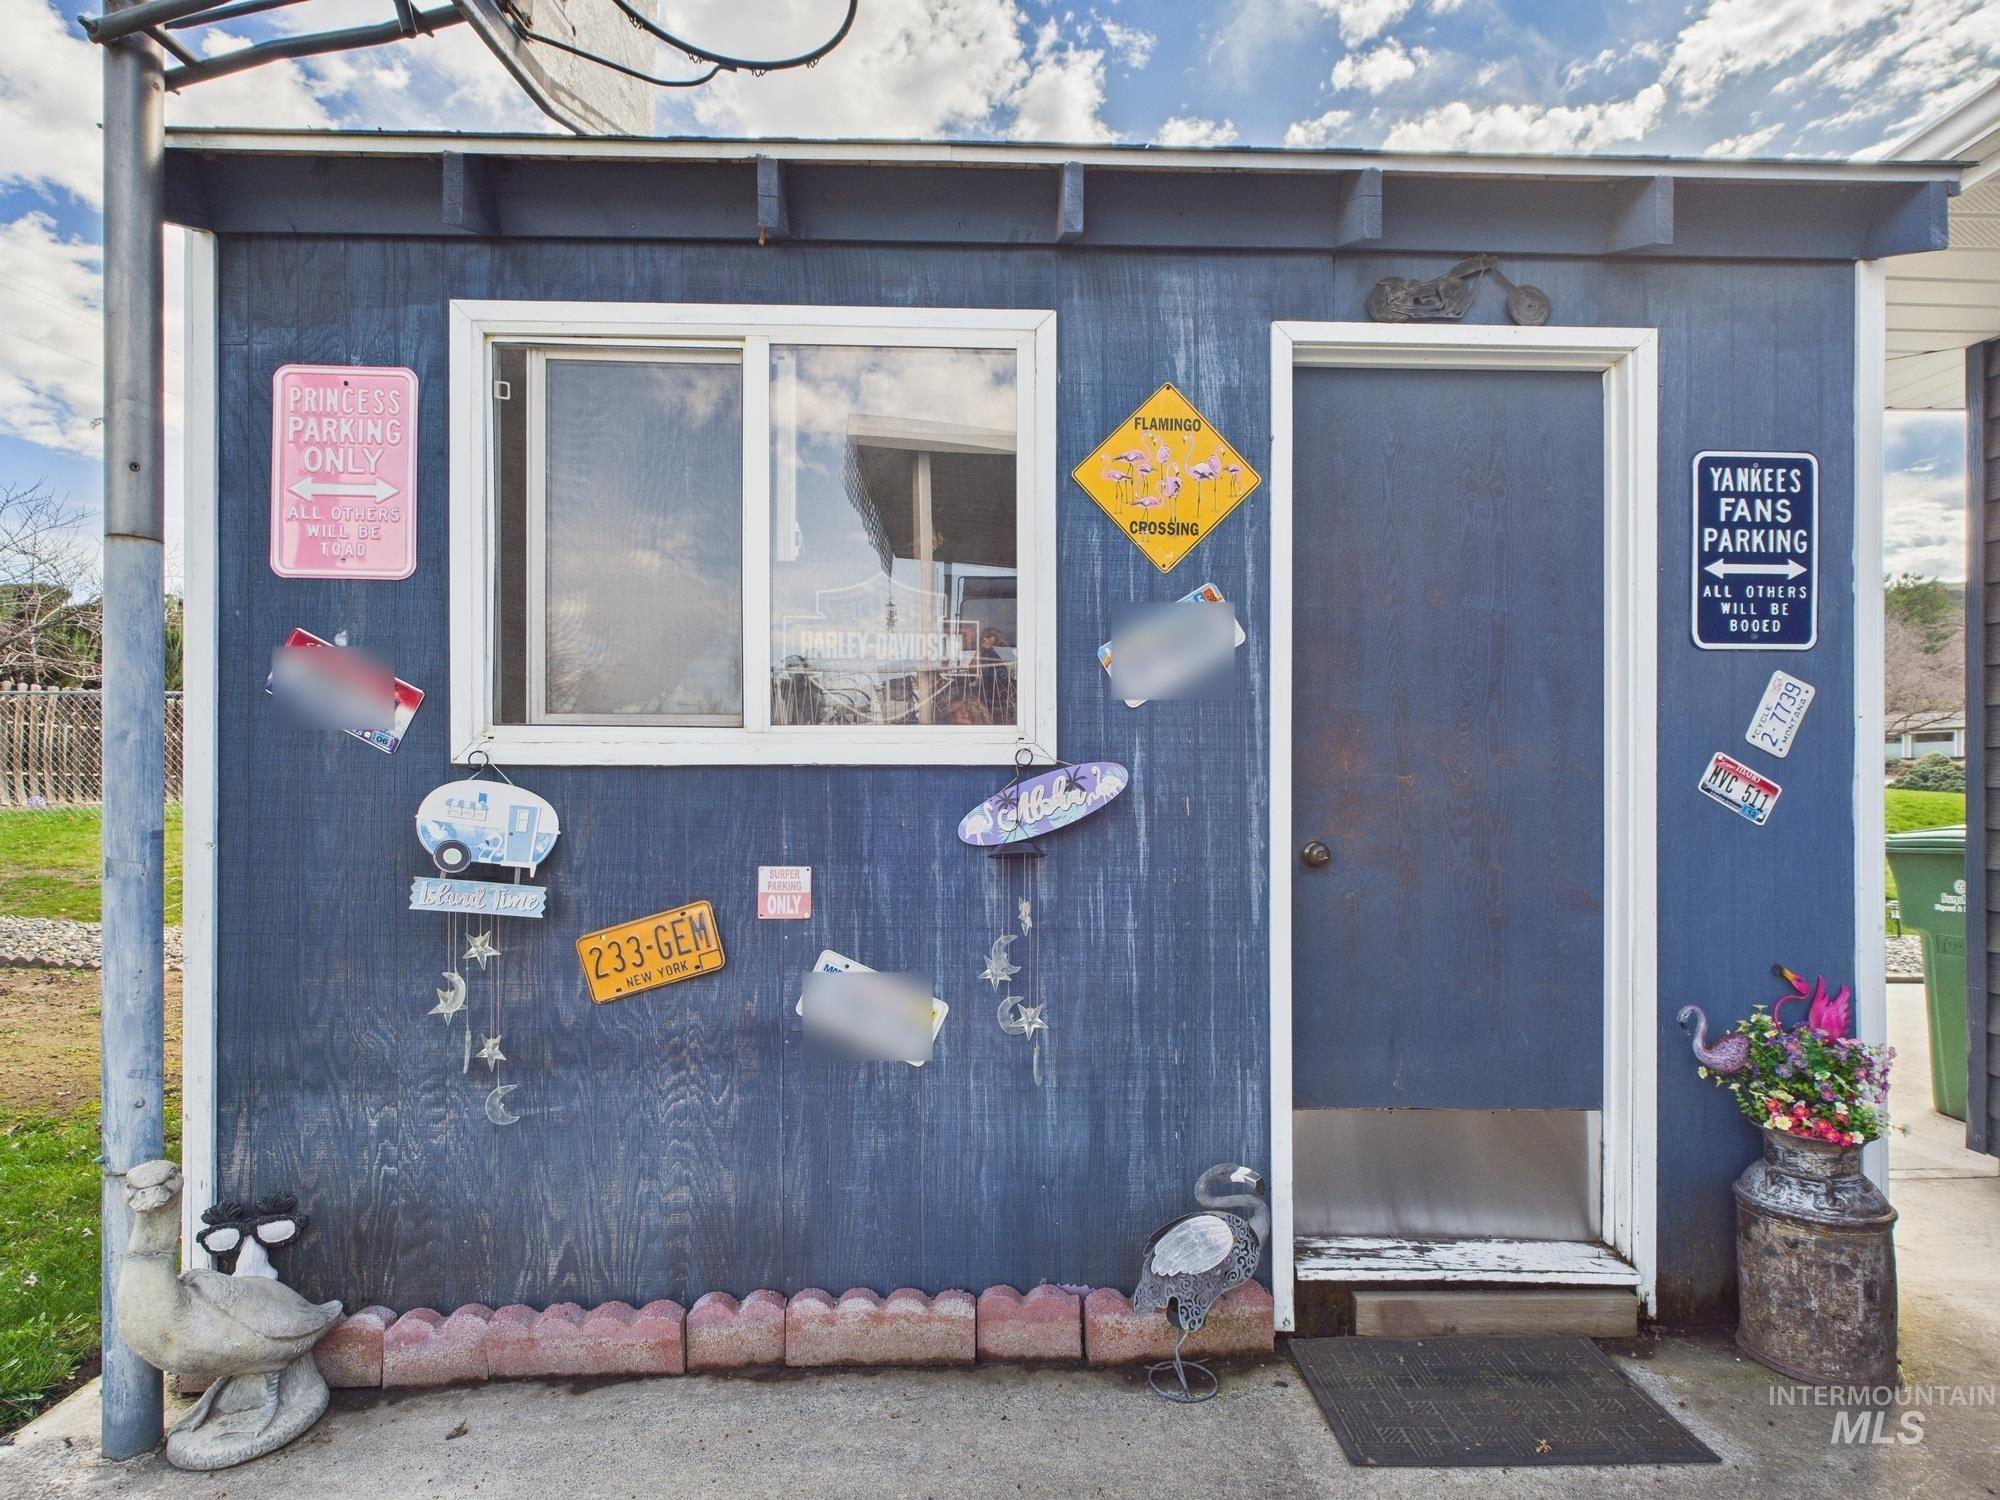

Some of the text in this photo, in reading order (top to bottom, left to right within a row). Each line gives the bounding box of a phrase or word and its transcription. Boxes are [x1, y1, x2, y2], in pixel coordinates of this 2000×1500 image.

[288, 386, 401, 415] PRINCESS
[287, 417, 401, 446] PARKING
[1134, 416, 1201, 432] FLAMINGO
[302, 446, 384, 475] ONLY
[1710, 467, 1801, 493] YANKEES
[286, 507, 401, 522] ALL OTHERS
[1719, 497, 1792, 523] FANS
[306, 523, 382, 540] WILL BE
[1129, 520, 1199, 536] CROSSING
[320, 542, 367, 557] TOAD
[1703, 527, 1808, 554] PARKING
[1703, 585, 1807, 599] ALL OTHERS
[1721, 602, 1789, 616] WILL BE
[1729, 619, 1781, 633] BOOED
[1754, 704, 1774, 736] CYCLE
[1734, 766, 1761, 784] IDAHO
[1708, 765, 1738, 794] MVC
[1741, 783, 1771, 813] 511
[997, 775, 1087, 832] Aloha
[769, 868, 801, 880] SURFER
[416, 880, 541, 912] Island Time
[767, 880, 802, 892] PARKING
[767, 894, 802, 915] ONLY
[588, 911, 712, 980] 233-GEM
[625, 960, 689, 988] NEW YORK
